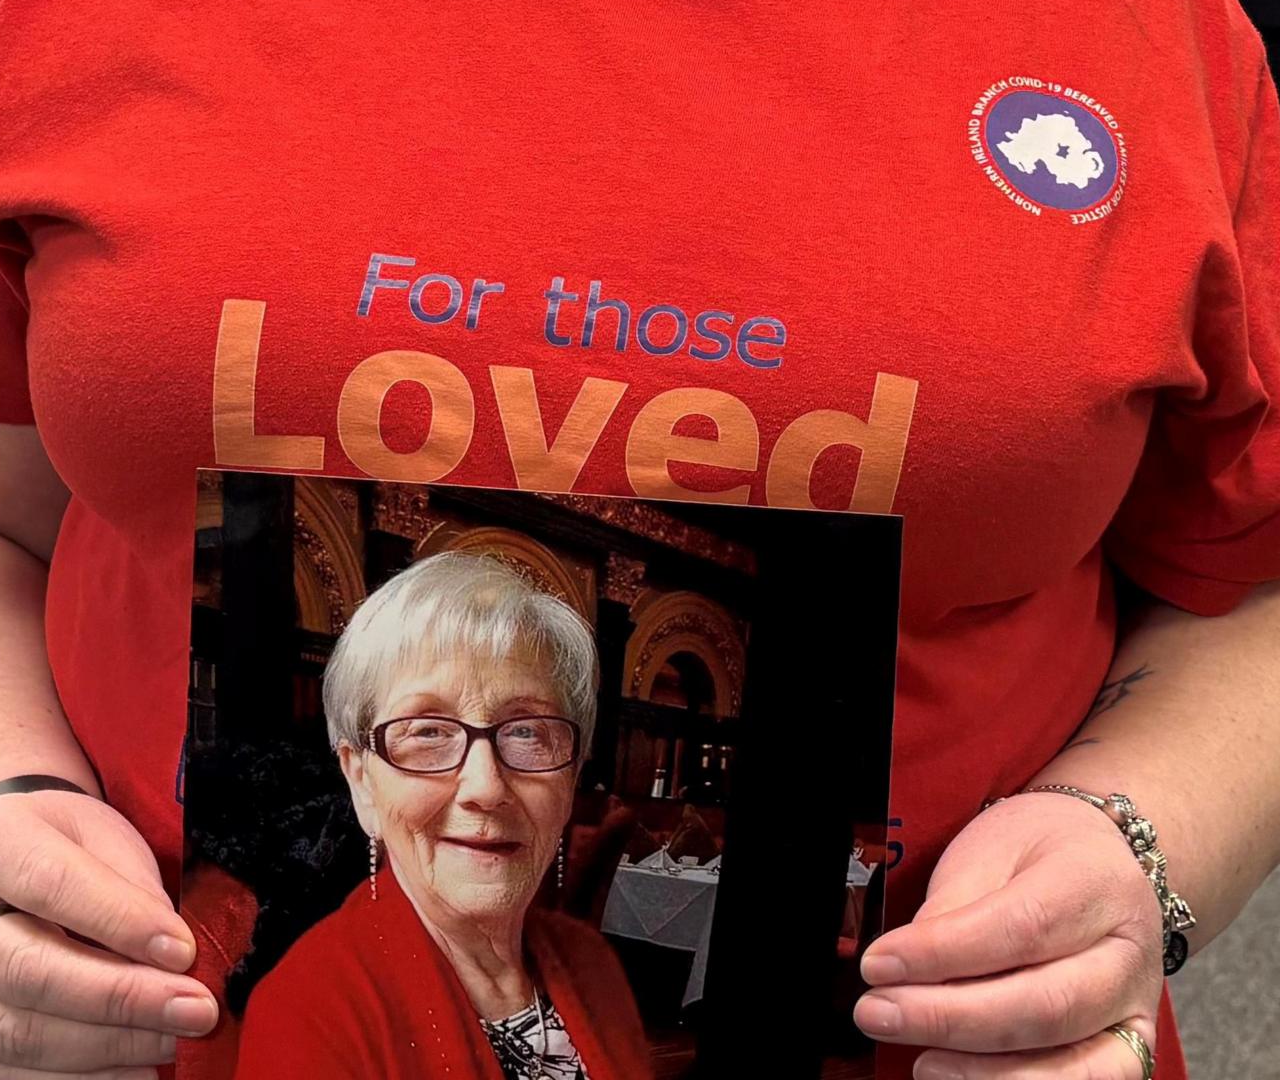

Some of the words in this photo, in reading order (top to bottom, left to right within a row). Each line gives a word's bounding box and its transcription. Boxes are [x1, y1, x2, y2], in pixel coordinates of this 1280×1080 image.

[971, 80, 1009, 116] BRANCH
[1008, 76, 1062, 92] COVID-19
[1064, 88, 1118, 130] BEREAVED
[968, 119, 989, 165] IRELAND
[983, 165, 1041, 216] NORTHERN
[1071, 201, 1112, 225] JUSTICE
[356, 253, 505, 330] For
[544, 275, 787, 370] those
[213, 298, 919, 514] Loved
